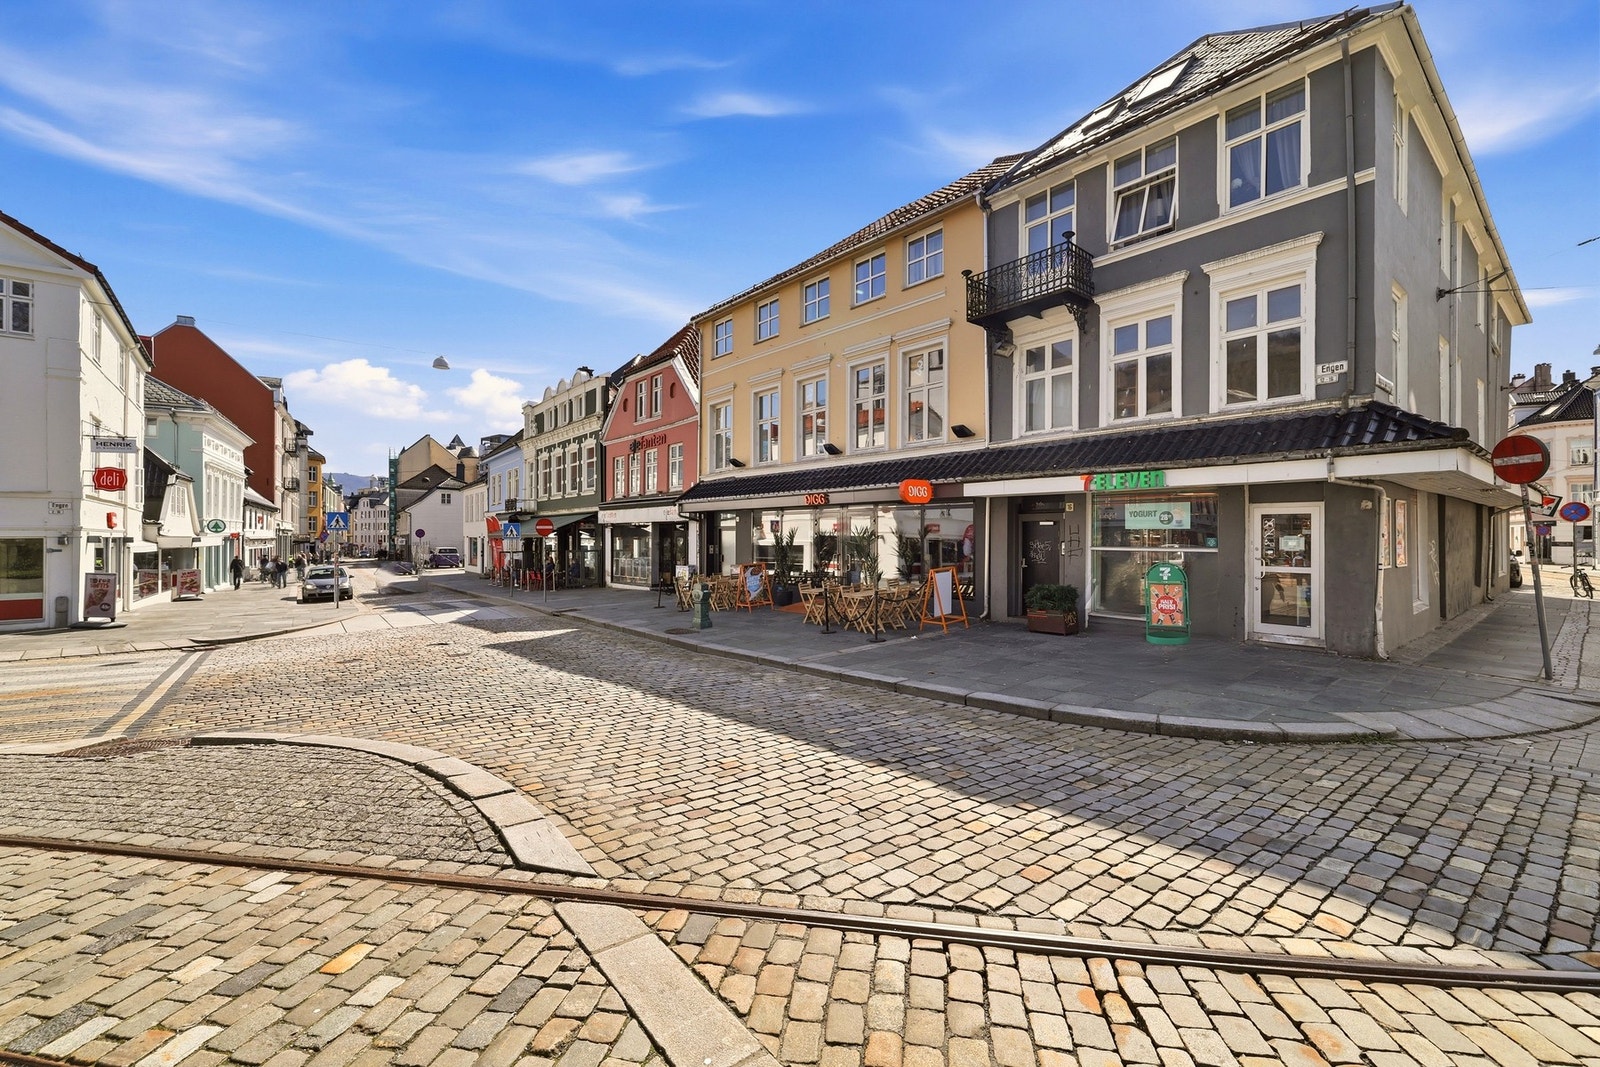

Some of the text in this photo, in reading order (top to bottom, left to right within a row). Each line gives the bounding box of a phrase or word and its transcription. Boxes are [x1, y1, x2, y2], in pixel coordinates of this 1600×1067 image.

[1321, 363, 1344, 374] Engen
[100, 471, 120, 486] deli
[908, 485, 928, 498] DIGG
[803, 493, 826, 506] DIGG
[1129, 510, 1158, 518] YOGURT
